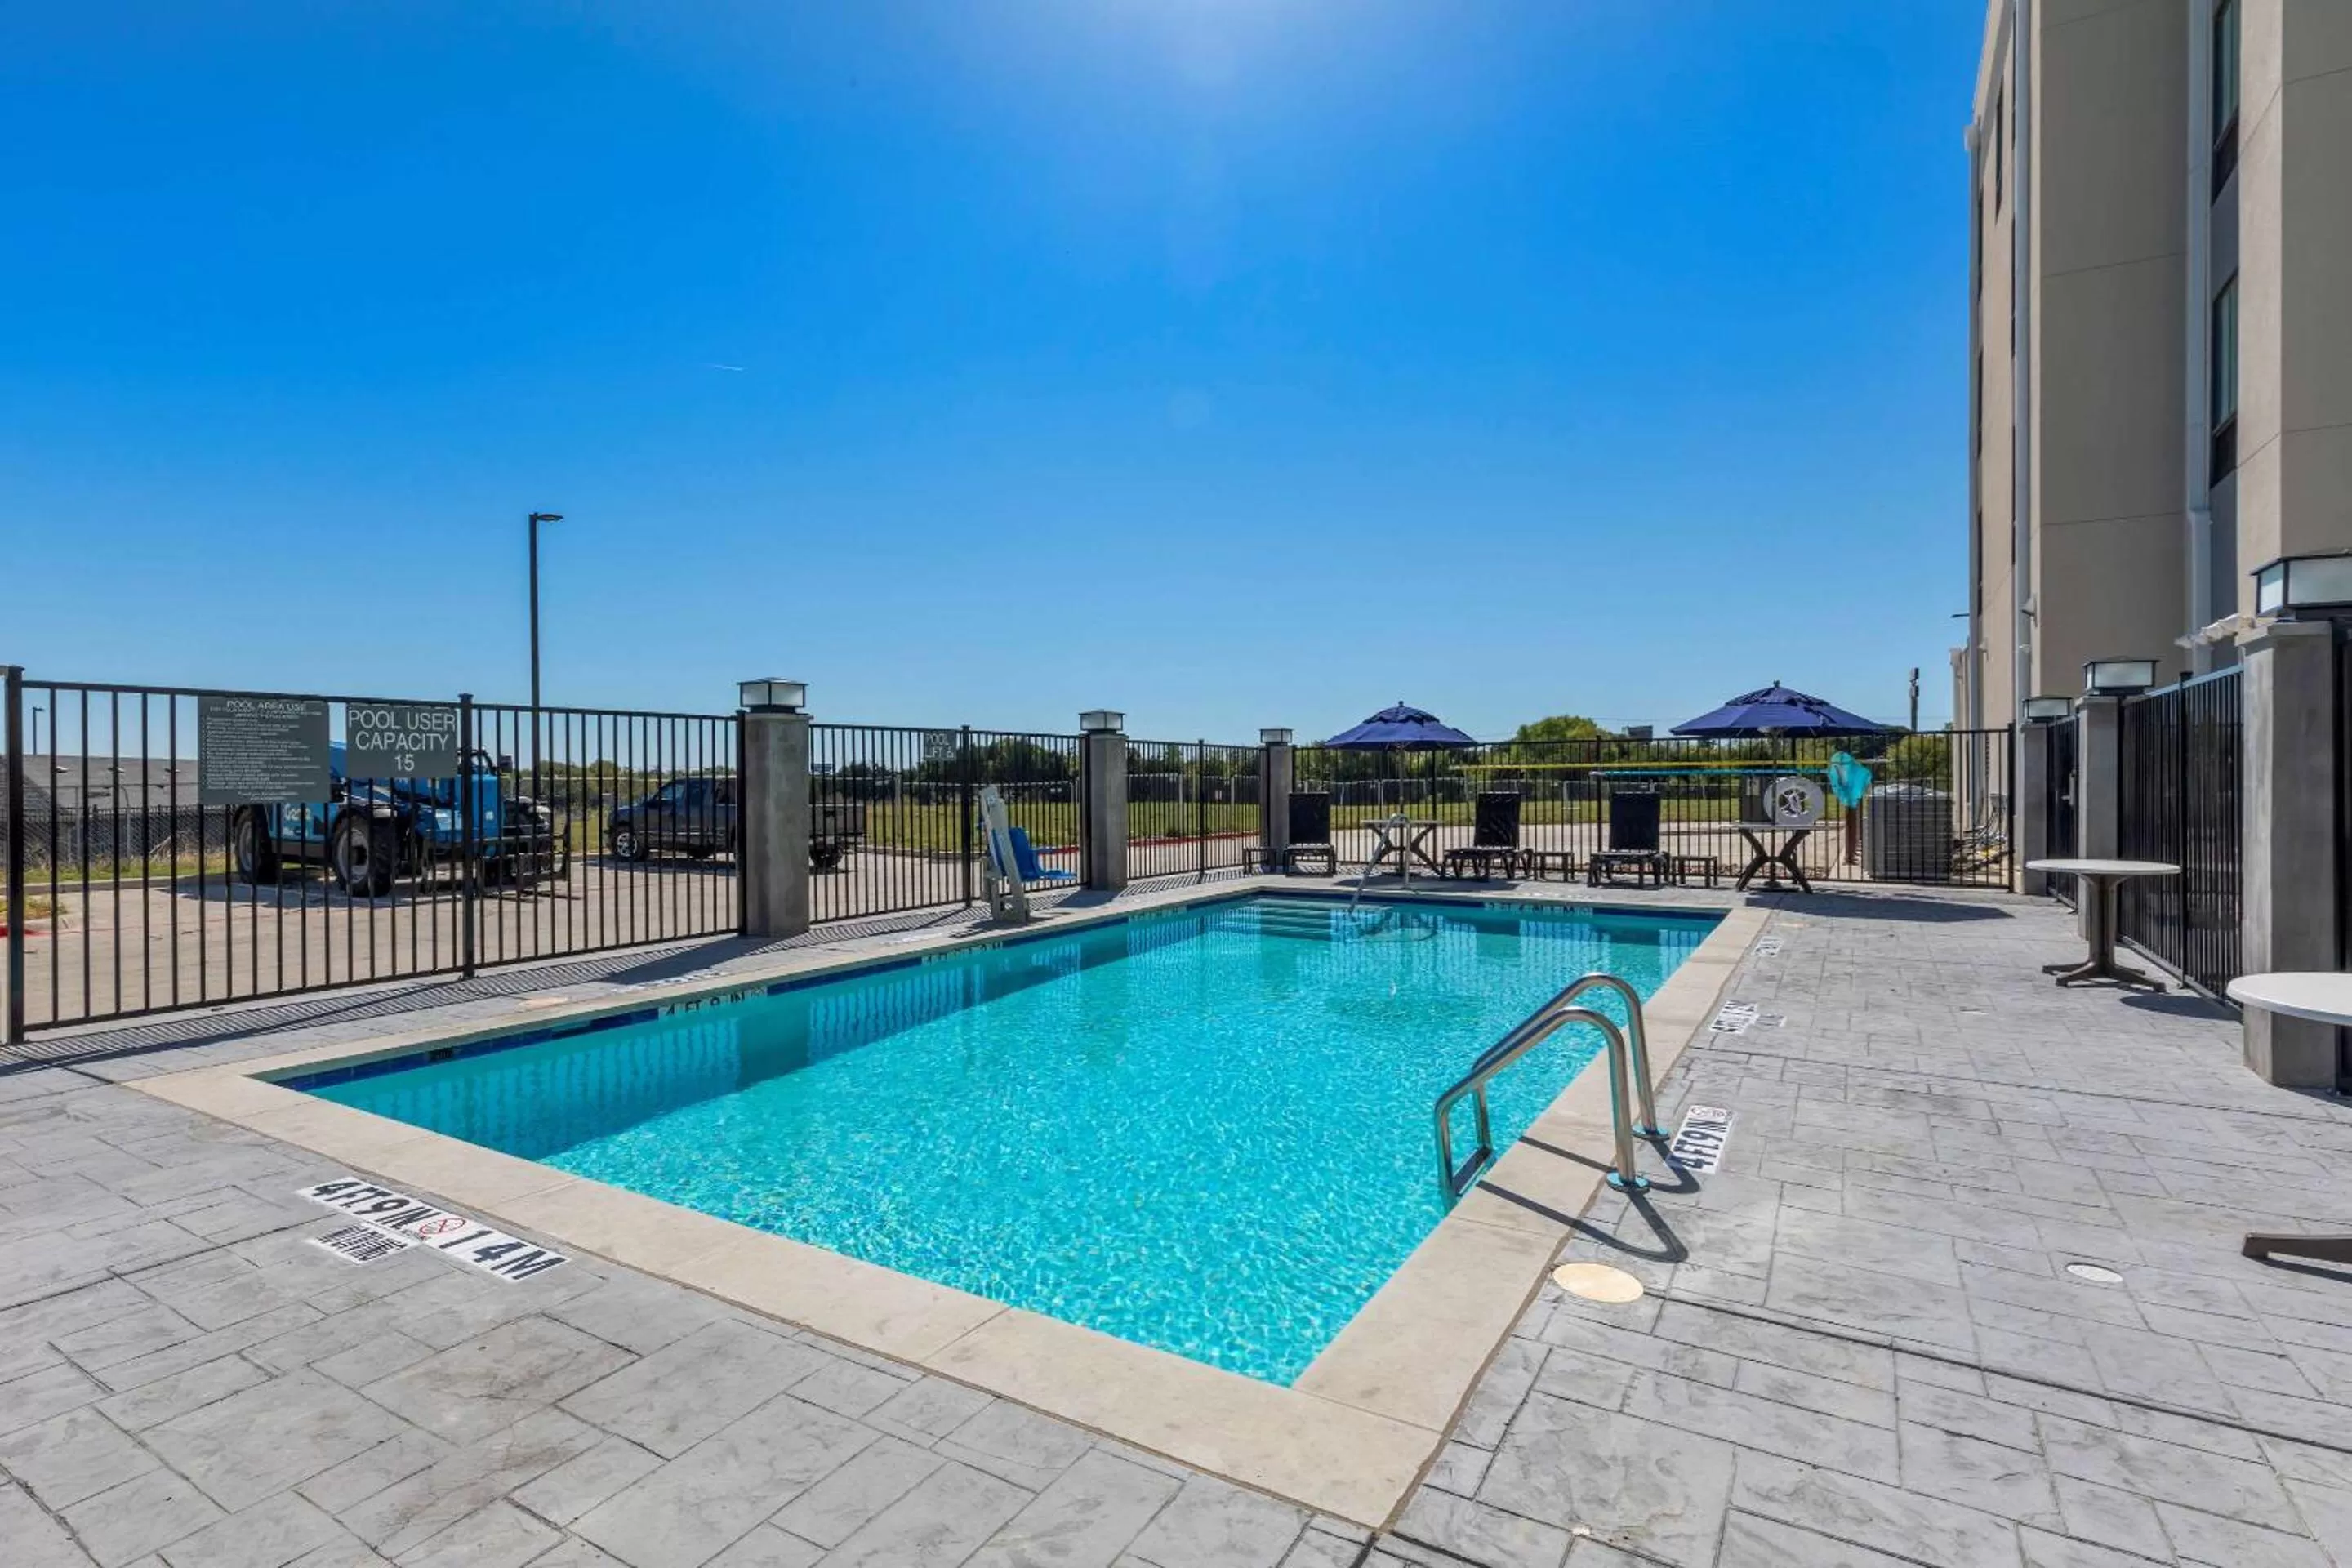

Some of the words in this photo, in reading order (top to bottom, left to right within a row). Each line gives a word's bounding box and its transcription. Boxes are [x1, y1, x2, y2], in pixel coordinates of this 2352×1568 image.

[226, 700, 252, 709] POOL
[258, 702, 284, 710] AREA
[286, 703, 306, 711] USE
[348, 709, 401, 729] POOL
[407, 711, 456, 732] USER
[355, 730, 448, 751] CAPACITY
[924, 733, 950, 746] POOL
[394, 754, 415, 772] 15
